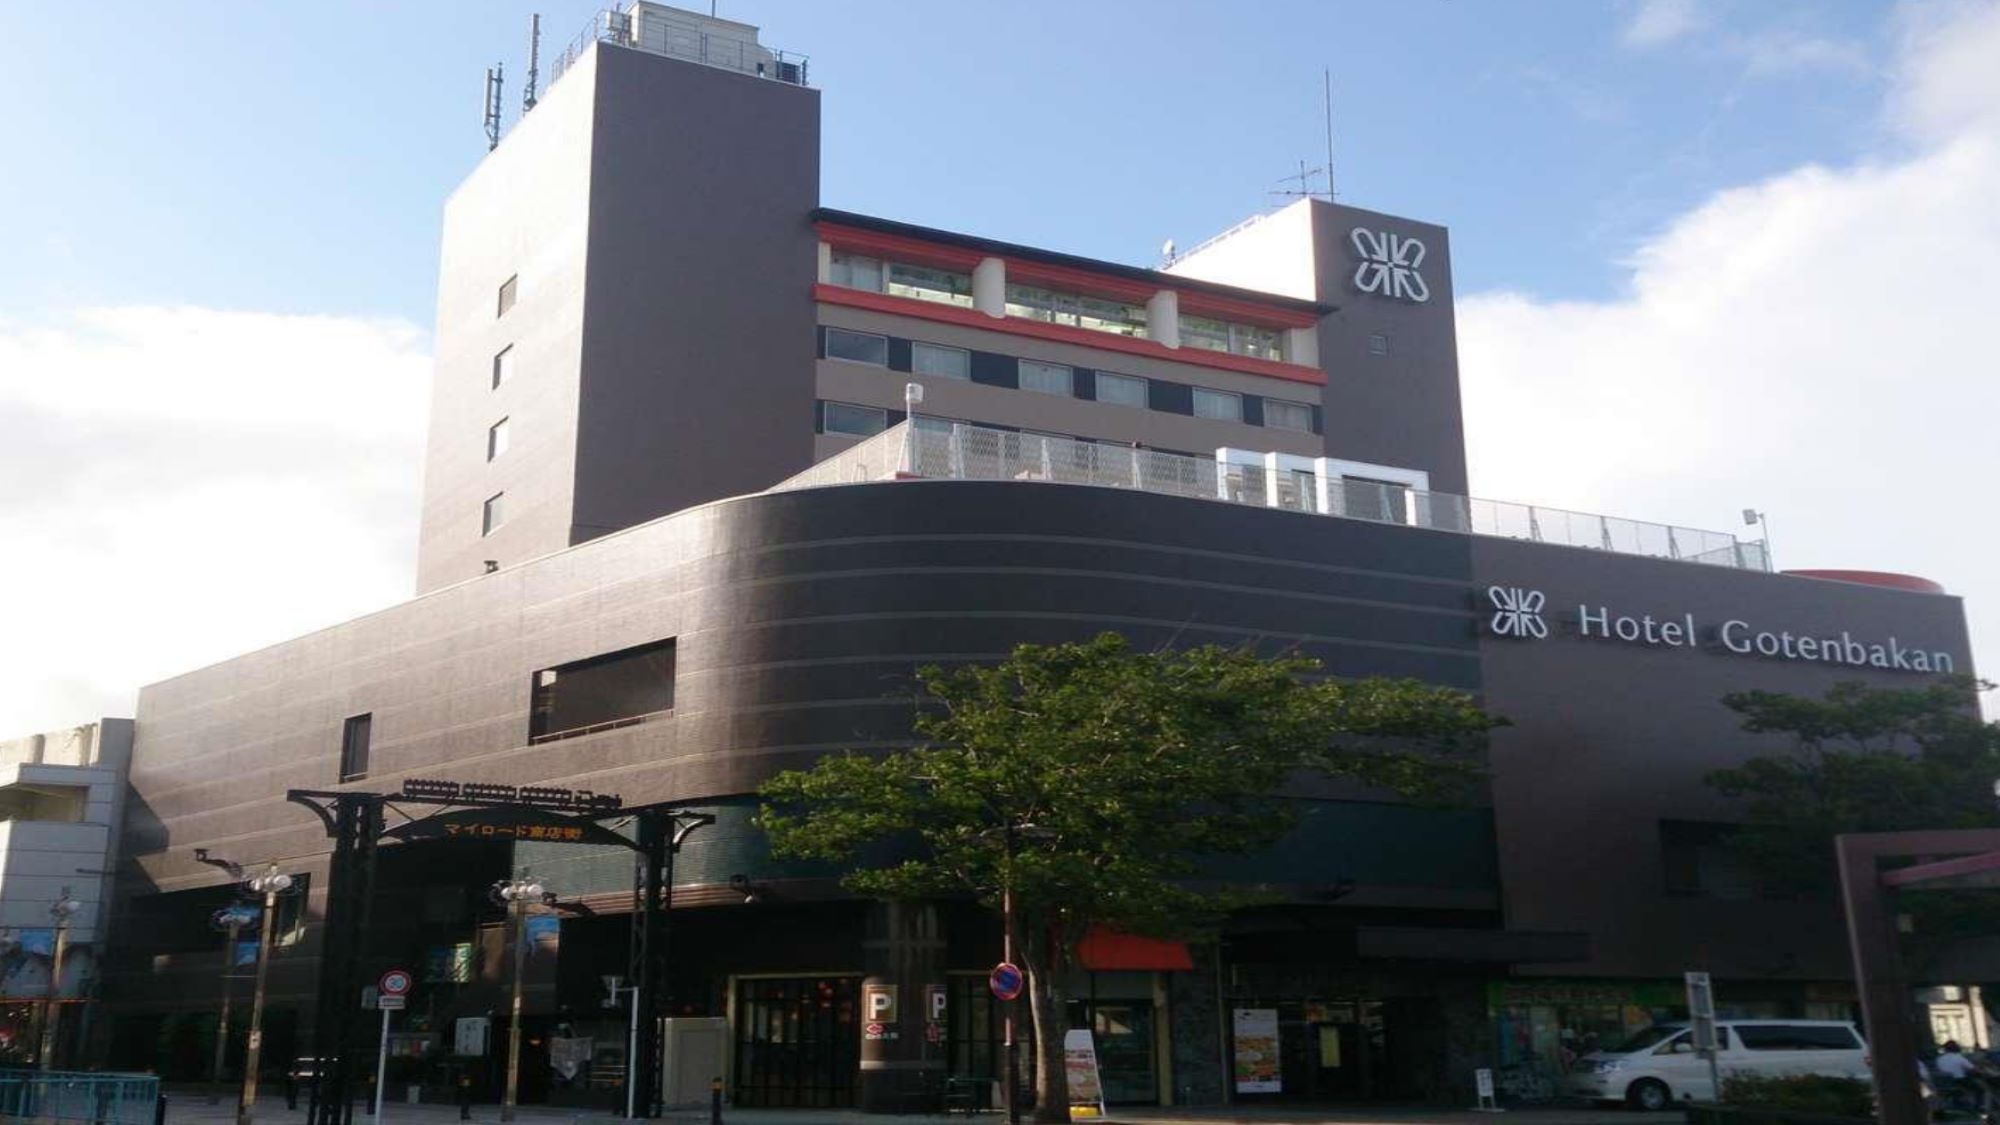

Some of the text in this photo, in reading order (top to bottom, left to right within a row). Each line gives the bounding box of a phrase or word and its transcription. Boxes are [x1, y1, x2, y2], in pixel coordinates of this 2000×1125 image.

[1579, 604, 1954, 673] Hotel Gotenbakan
[869, 993, 892, 1020] P
[932, 993, 947, 1019] P
